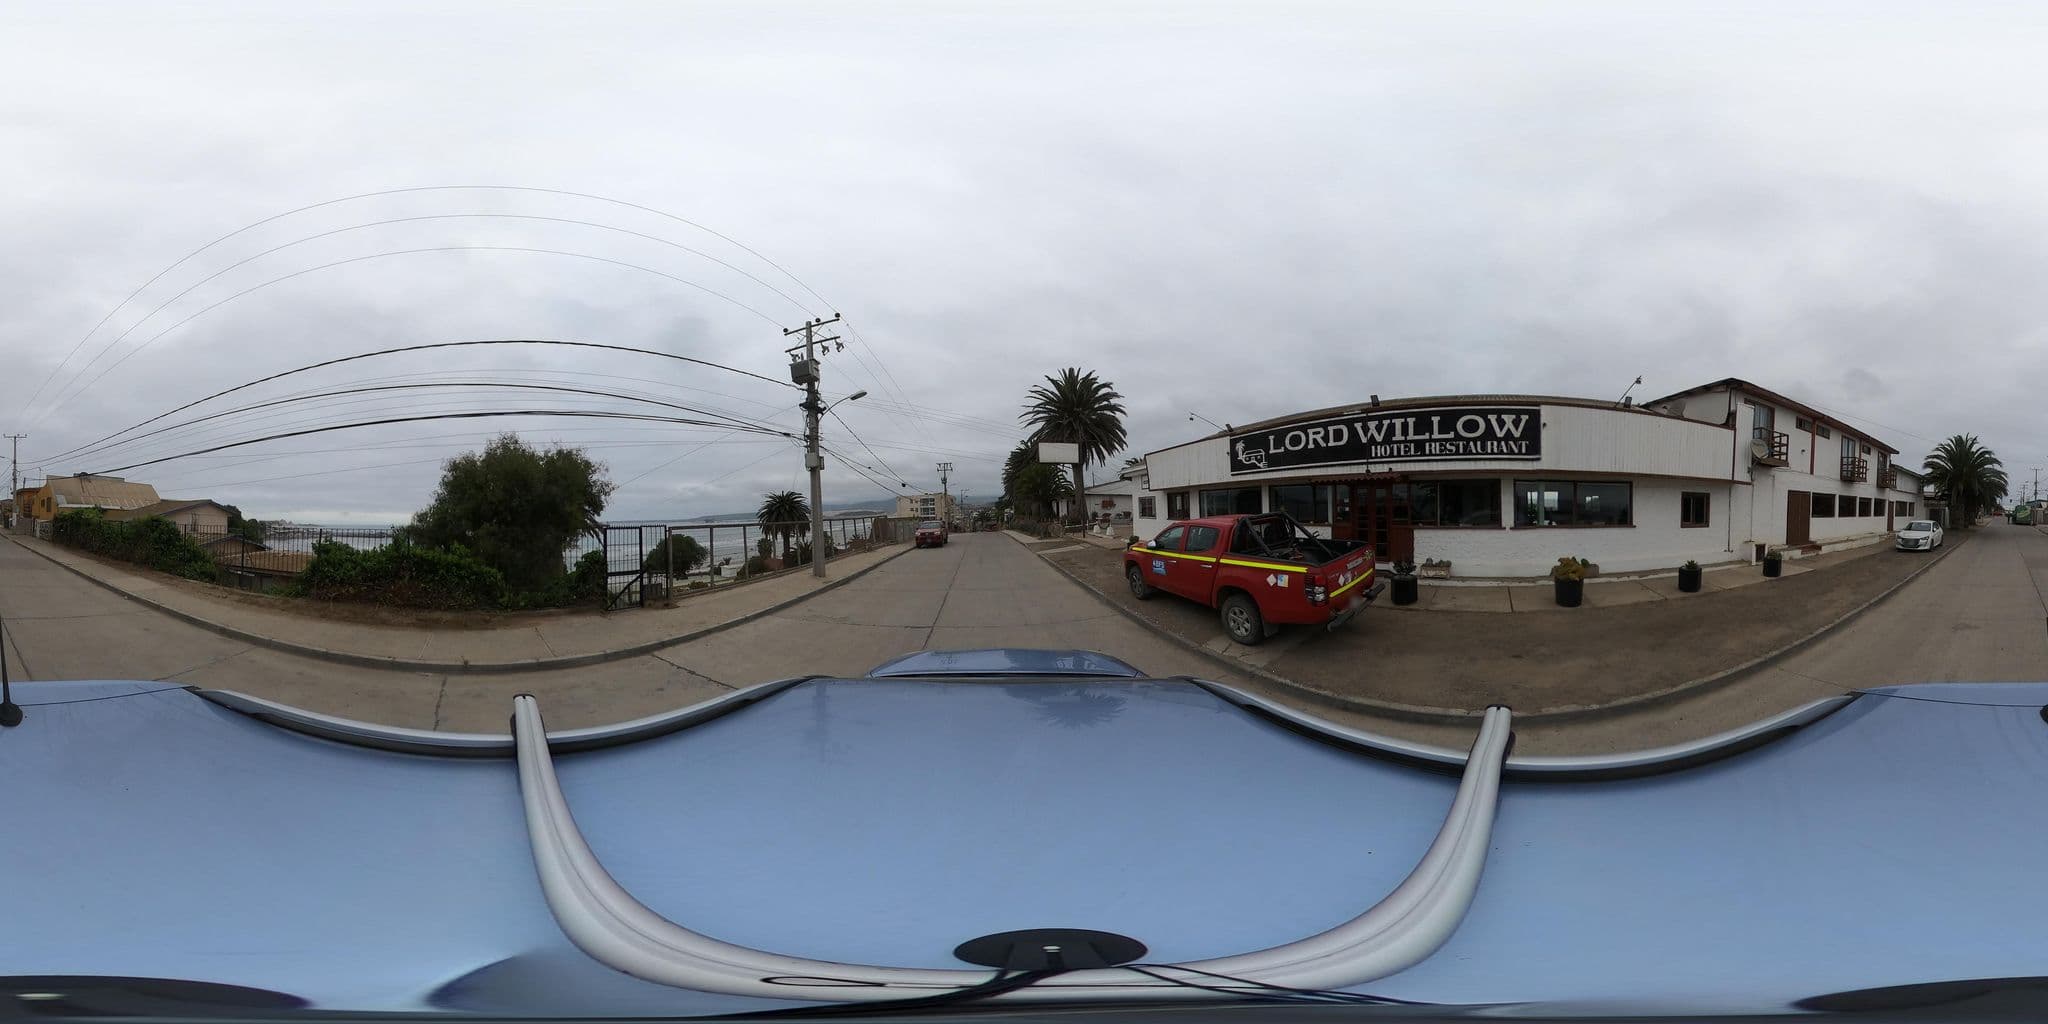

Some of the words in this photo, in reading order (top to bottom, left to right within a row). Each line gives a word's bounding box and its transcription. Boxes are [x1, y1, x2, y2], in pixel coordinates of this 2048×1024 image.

[1269, 425, 1348, 453] LORD
[1354, 415, 1529, 443] WILLOW
[1371, 443, 1421, 457] HOTEL
[1425, 440, 1529, 455] RESTAURANT
